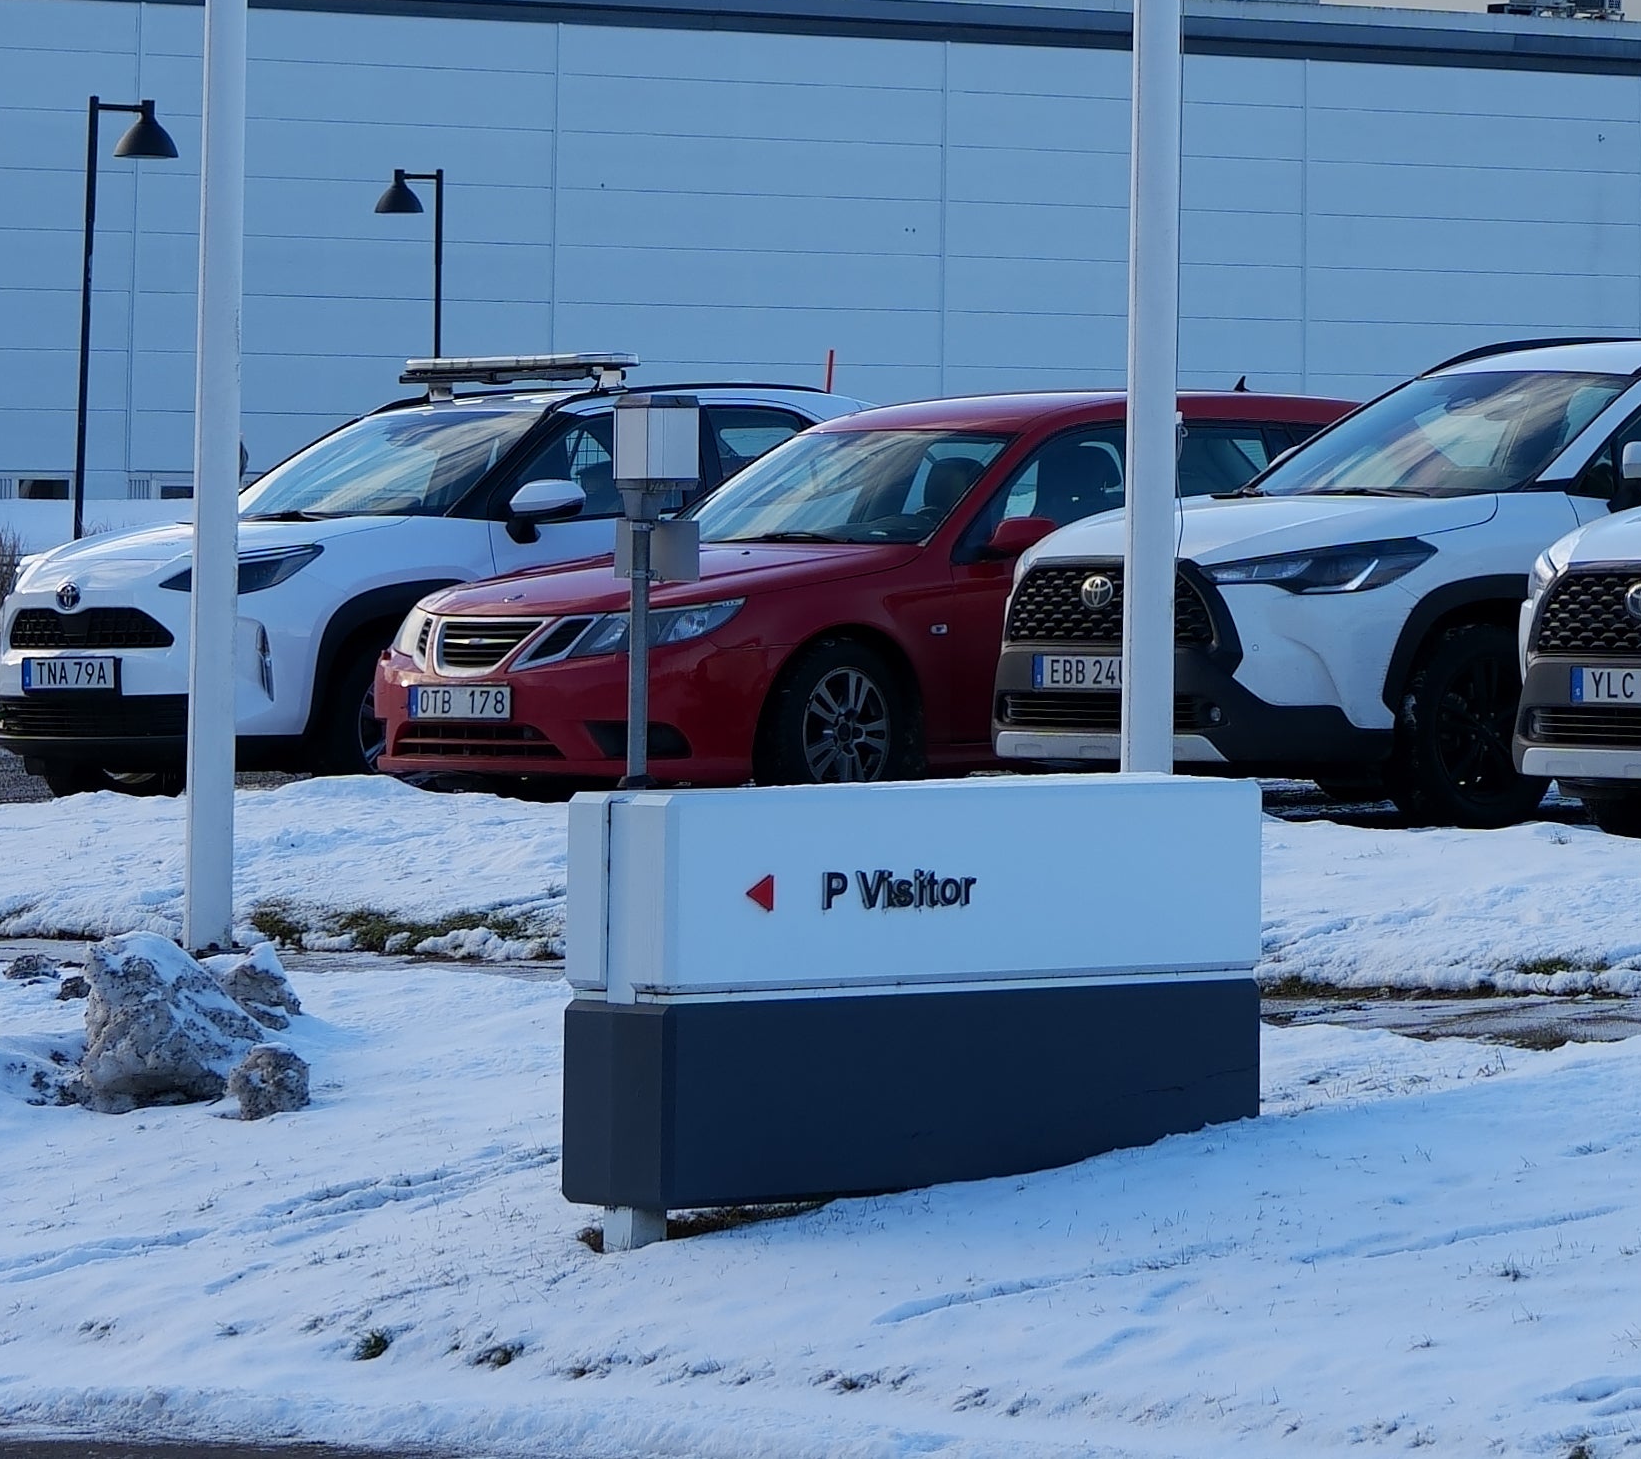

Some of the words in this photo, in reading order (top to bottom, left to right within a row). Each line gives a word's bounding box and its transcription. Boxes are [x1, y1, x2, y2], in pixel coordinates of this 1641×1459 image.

[36, 662, 68, 685] TNA
[73, 662, 107, 685] 79A
[1050, 659, 1086, 685] EBB
[1591, 671, 1635, 699] YLC
[420, 689, 452, 714] OTB
[469, 689, 505, 715] 178
[822, 871, 849, 911] P
[855, 868, 978, 910] Visitor
